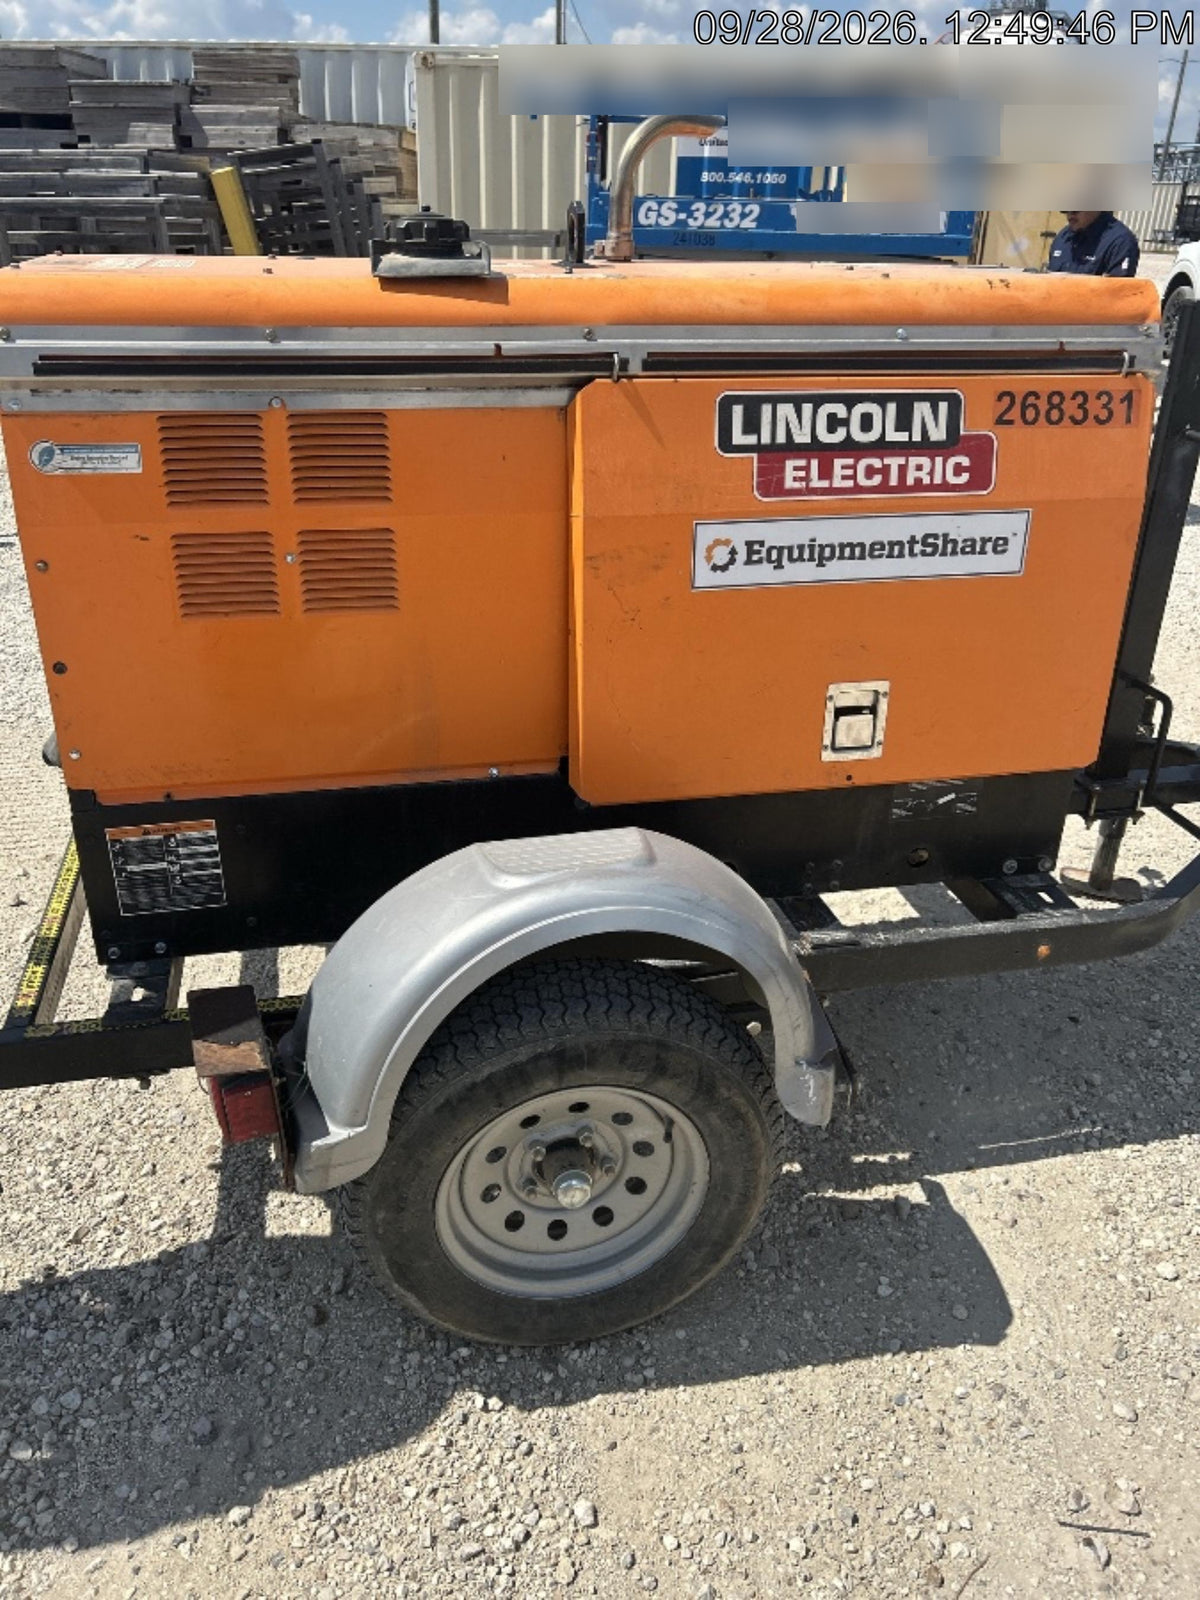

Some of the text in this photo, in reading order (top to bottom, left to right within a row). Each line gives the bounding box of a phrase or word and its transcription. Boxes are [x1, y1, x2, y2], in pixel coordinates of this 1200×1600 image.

[637, 201, 760, 229] GS-3232
[731, 401, 948, 445] LINCOLN
[995, 390, 1134, 426] 268331
[784, 456, 971, 489] ELECTRIC
[743, 533, 1009, 569] EquipmentShare
